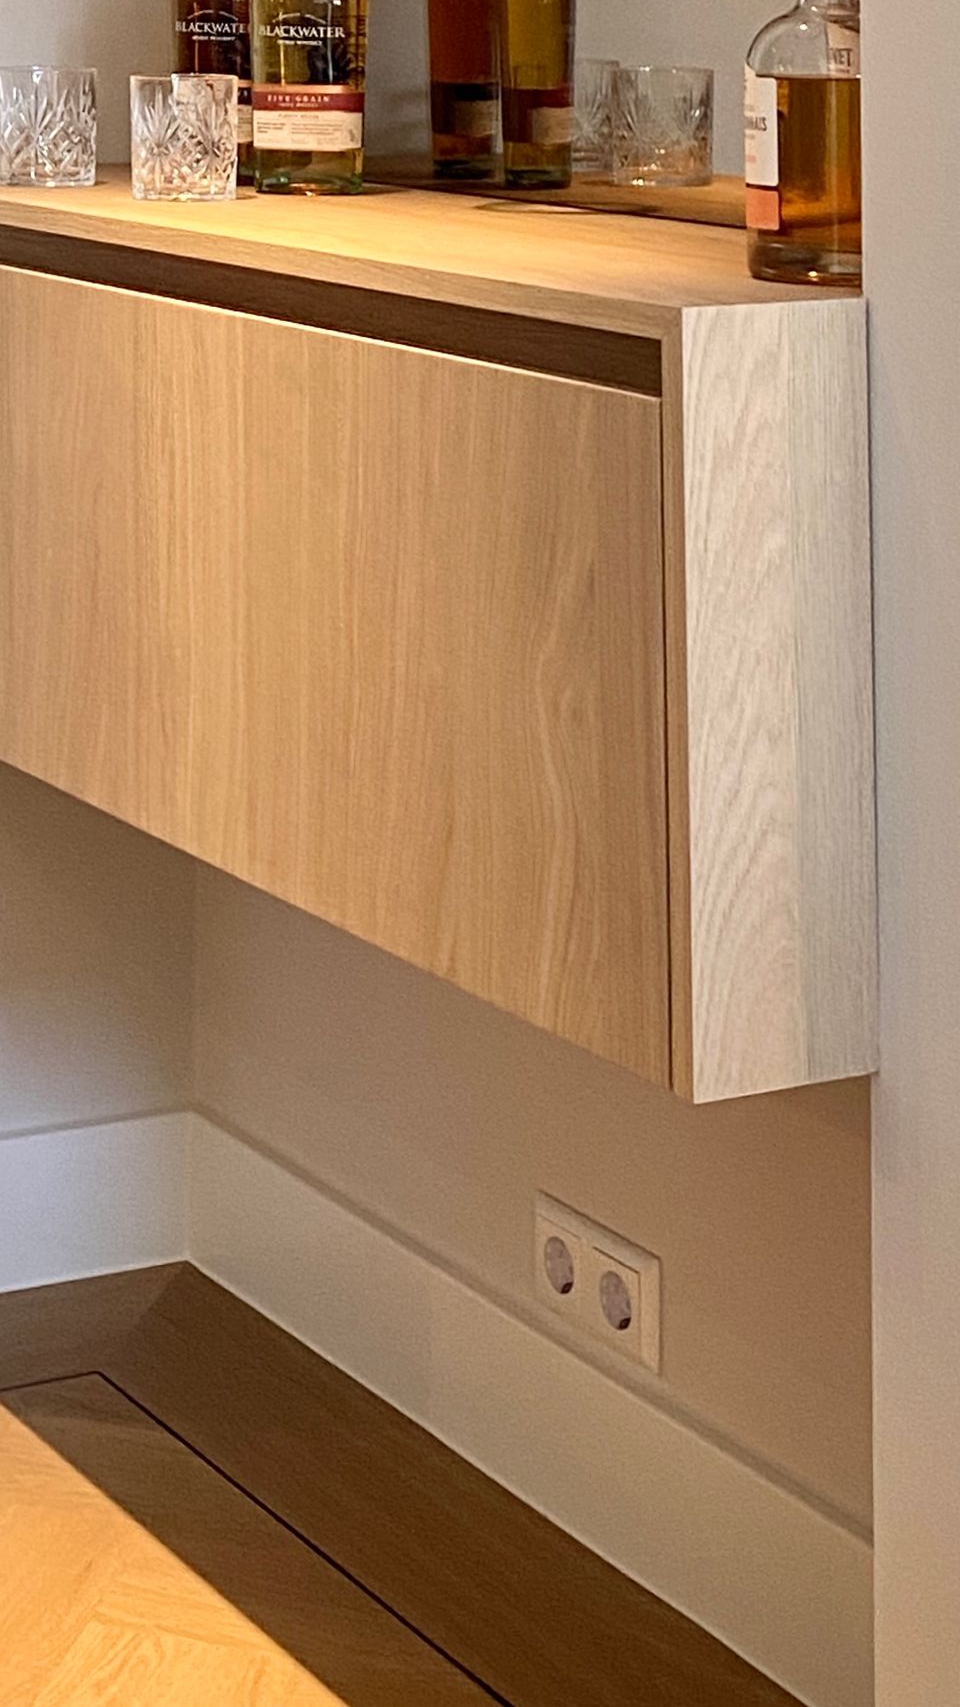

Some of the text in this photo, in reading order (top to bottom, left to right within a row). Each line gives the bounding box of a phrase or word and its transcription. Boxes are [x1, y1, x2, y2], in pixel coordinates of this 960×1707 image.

[175, 21, 250, 35] BLACKWATE
[259, 24, 346, 39] BLACKWATER
[267, 94, 330, 103] FIVE GRAIN
